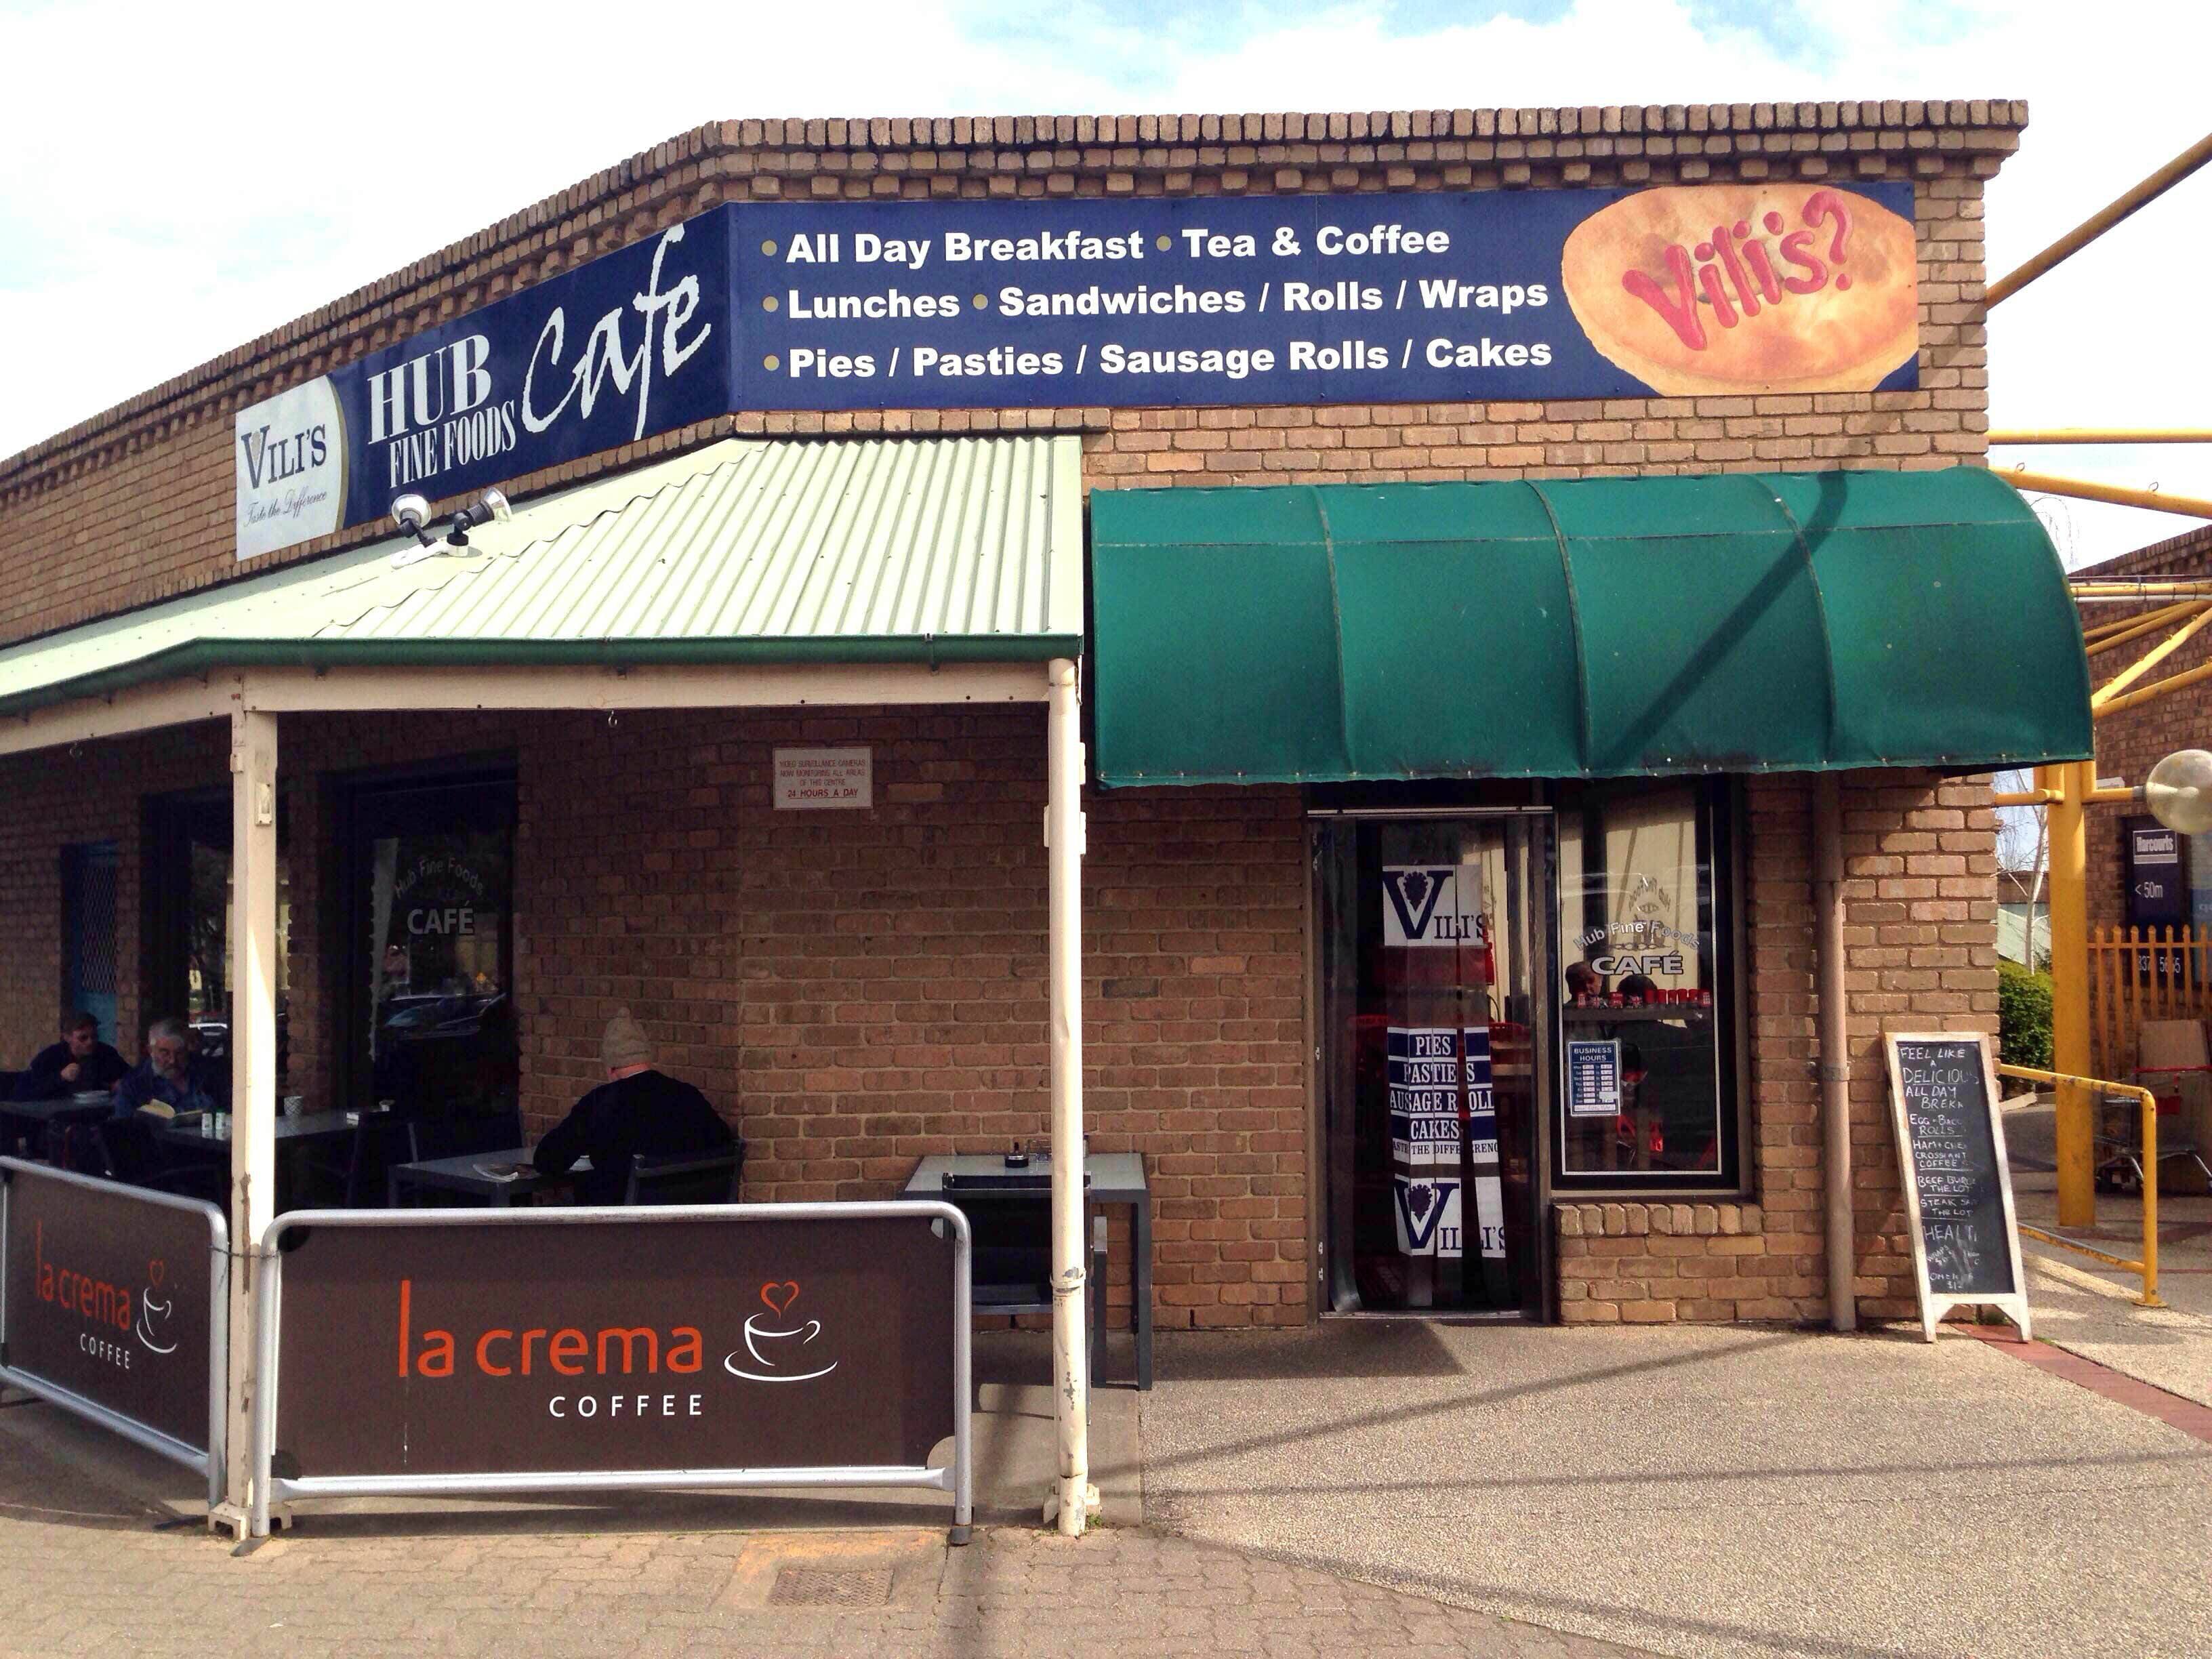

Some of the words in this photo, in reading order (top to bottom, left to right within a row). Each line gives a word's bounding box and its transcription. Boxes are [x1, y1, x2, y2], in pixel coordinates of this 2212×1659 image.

[786, 233, 840, 263] All
[855, 232, 931, 270] Day
[945, 230, 1144, 262] Breakfast
[1182, 228, 1256, 258] Tea
[1271, 227, 1302, 256] &
[1316, 224, 1450, 255] Coffee
[788, 289, 960, 319] Lunches
[998, 285, 1246, 317] Sandwiches
[1284, 281, 1383, 312] Rolls
[1418, 279, 1549, 314] Wraps
[789, 348, 876, 377] Pies
[913, 346, 1063, 376] Pasties
[1100, 344, 1275, 380] Sausage
[1289, 341, 1389, 371] Rolls
[1426, 337, 1552, 369] Cakes
[367, 334, 492, 445] HUB
[389, 427, 438, 489] FINE
[443, 400, 516, 470] FOODS
[241, 423, 327, 490] VILI'S
[787, 790, 796, 798] 24
[800, 789, 829, 797] HOURS
[843, 788, 859, 796] DAY
[2136, 834, 2174, 853] Harcourts
[419, 857, 444, 878] Fine
[2144, 882, 2163, 899] 50m
[407, 900, 474, 935] CAFÉ
[1573, 928, 1606, 951] Hub
[1610, 921, 1645, 935] Fine
[1652, 921, 1700, 950] Foods
[1591, 949, 1683, 976] CAFÉ
[1415, 1034, 1451, 1056] PIES
[1900, 1047, 1931, 1060] FEEL
[1938, 1048, 1966, 1059] LIKE
[1906, 1086, 1928, 1097] ALL
[1931, 1086, 1957, 1099] DAY
[1910, 1113, 1930, 1125] EGG
[1410, 1120, 1460, 1140] CAKES
[1919, 1125, 1954, 1136] ROLLS
[1411, 1143, 1431, 1155] THE
[1919, 1159, 1957, 1168] COFFEE
[1917, 1176, 1944, 1188] BEEF
[1929, 1185, 1952, 1193] THE
[1953, 1185, 1971, 1193] LOT
[1920, 1199, 1957, 1208] STEAK
[1932, 1208, 1950, 1216] THE
[1953, 1209, 1973, 1217] LOT
[35, 1220, 54, 1302] la
[58, 1267, 131, 1332] crema
[398, 1279, 455, 1378] la
[476, 1326, 703, 1376] crema
[79, 1333, 130, 1370] COFFEE
[549, 1394, 703, 1418] COFFEE
